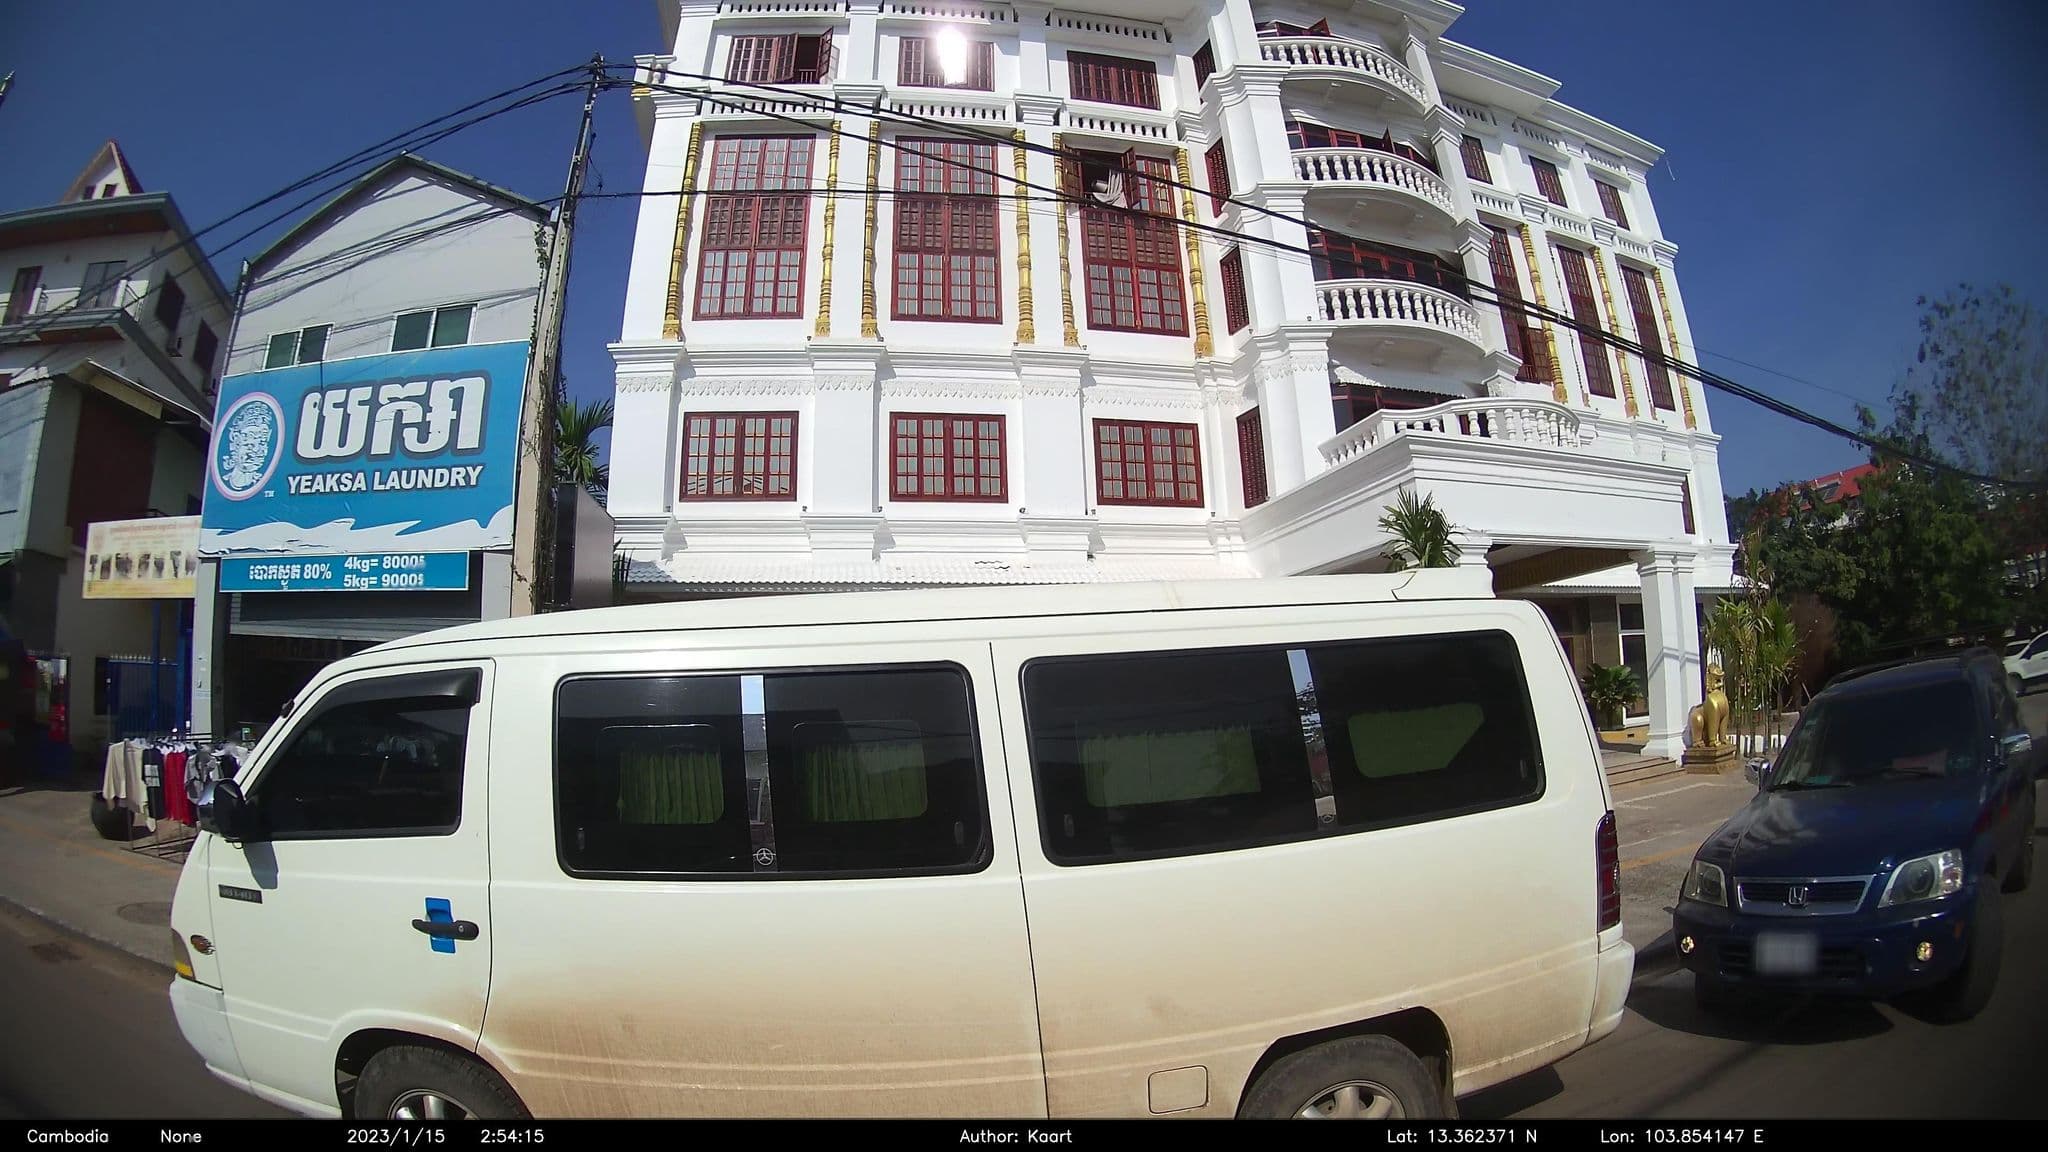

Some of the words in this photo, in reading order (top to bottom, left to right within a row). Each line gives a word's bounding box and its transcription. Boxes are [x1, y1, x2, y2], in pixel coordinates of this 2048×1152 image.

[287, 472, 367, 494] YEAKSA
[372, 465, 484, 491] LAUNDRY
[303, 563, 333, 580] 80%
